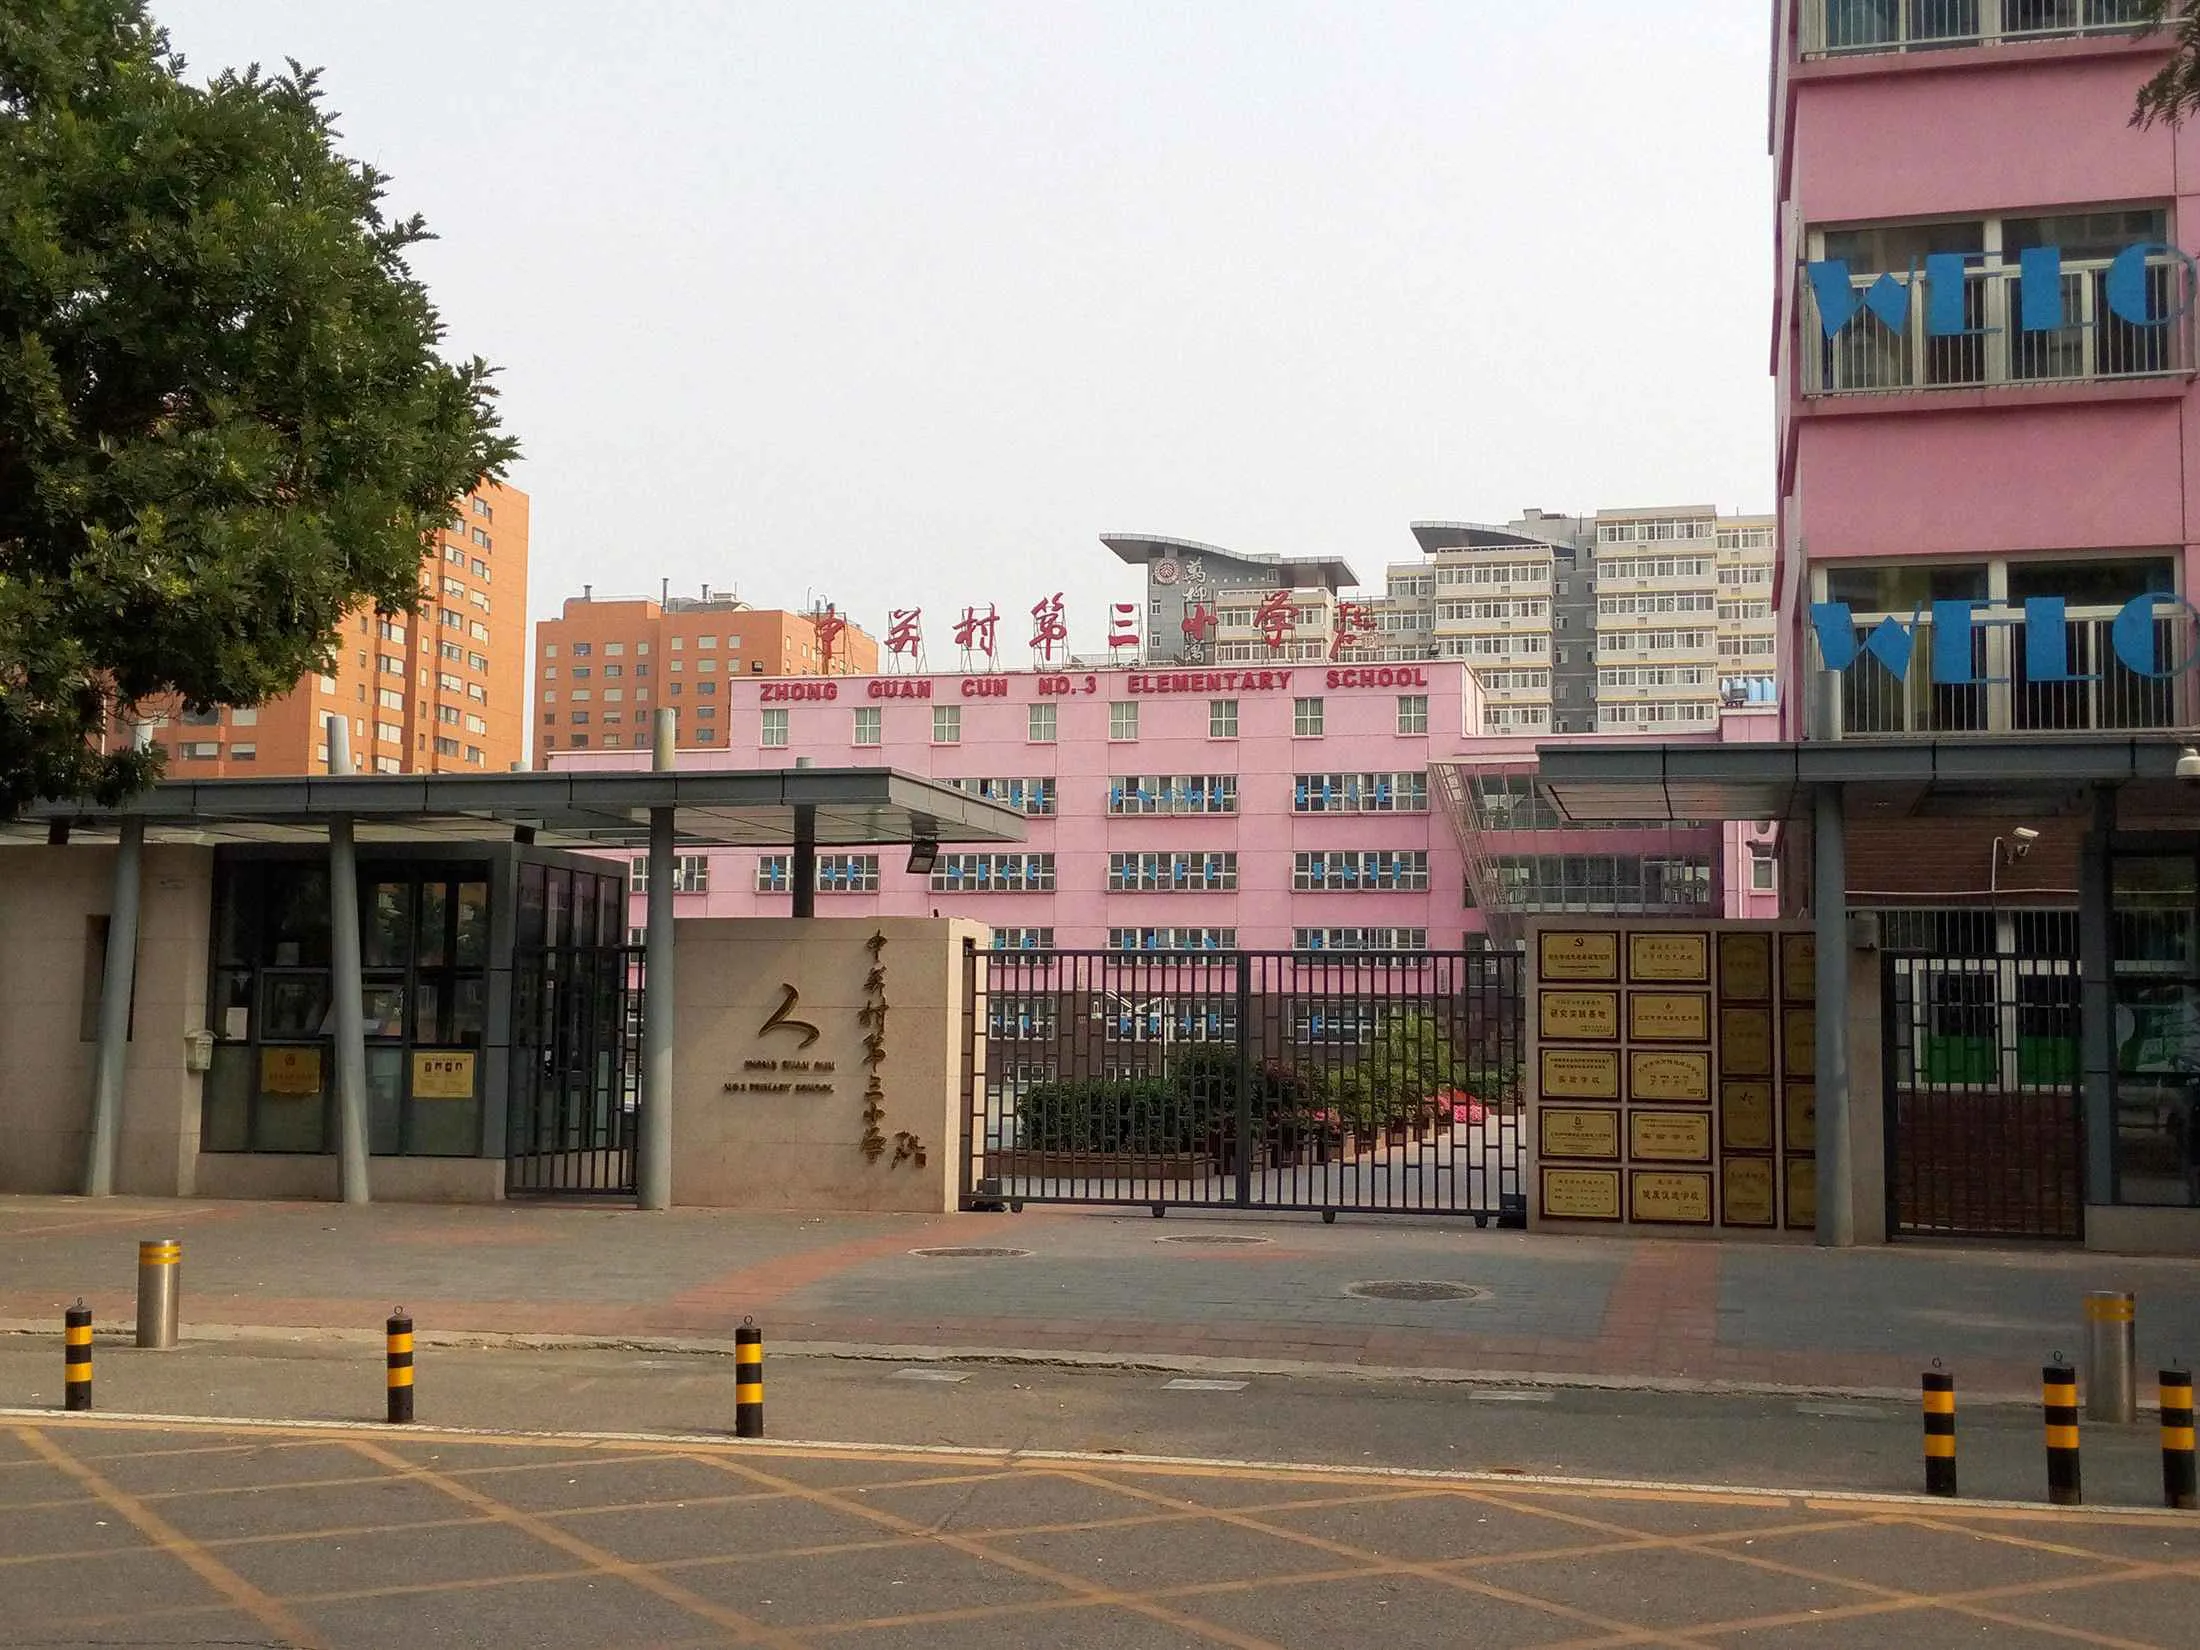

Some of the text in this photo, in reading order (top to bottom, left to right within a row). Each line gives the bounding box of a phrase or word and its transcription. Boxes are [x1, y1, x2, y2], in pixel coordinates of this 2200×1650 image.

[759, 682, 838, 702] ZHONG
[867, 680, 932, 699] GUAN
[961, 678, 1008, 697] CUN
[1128, 671, 1292, 693] ELEMENTARY
[1326, 667, 1428, 689] SCHOOL
